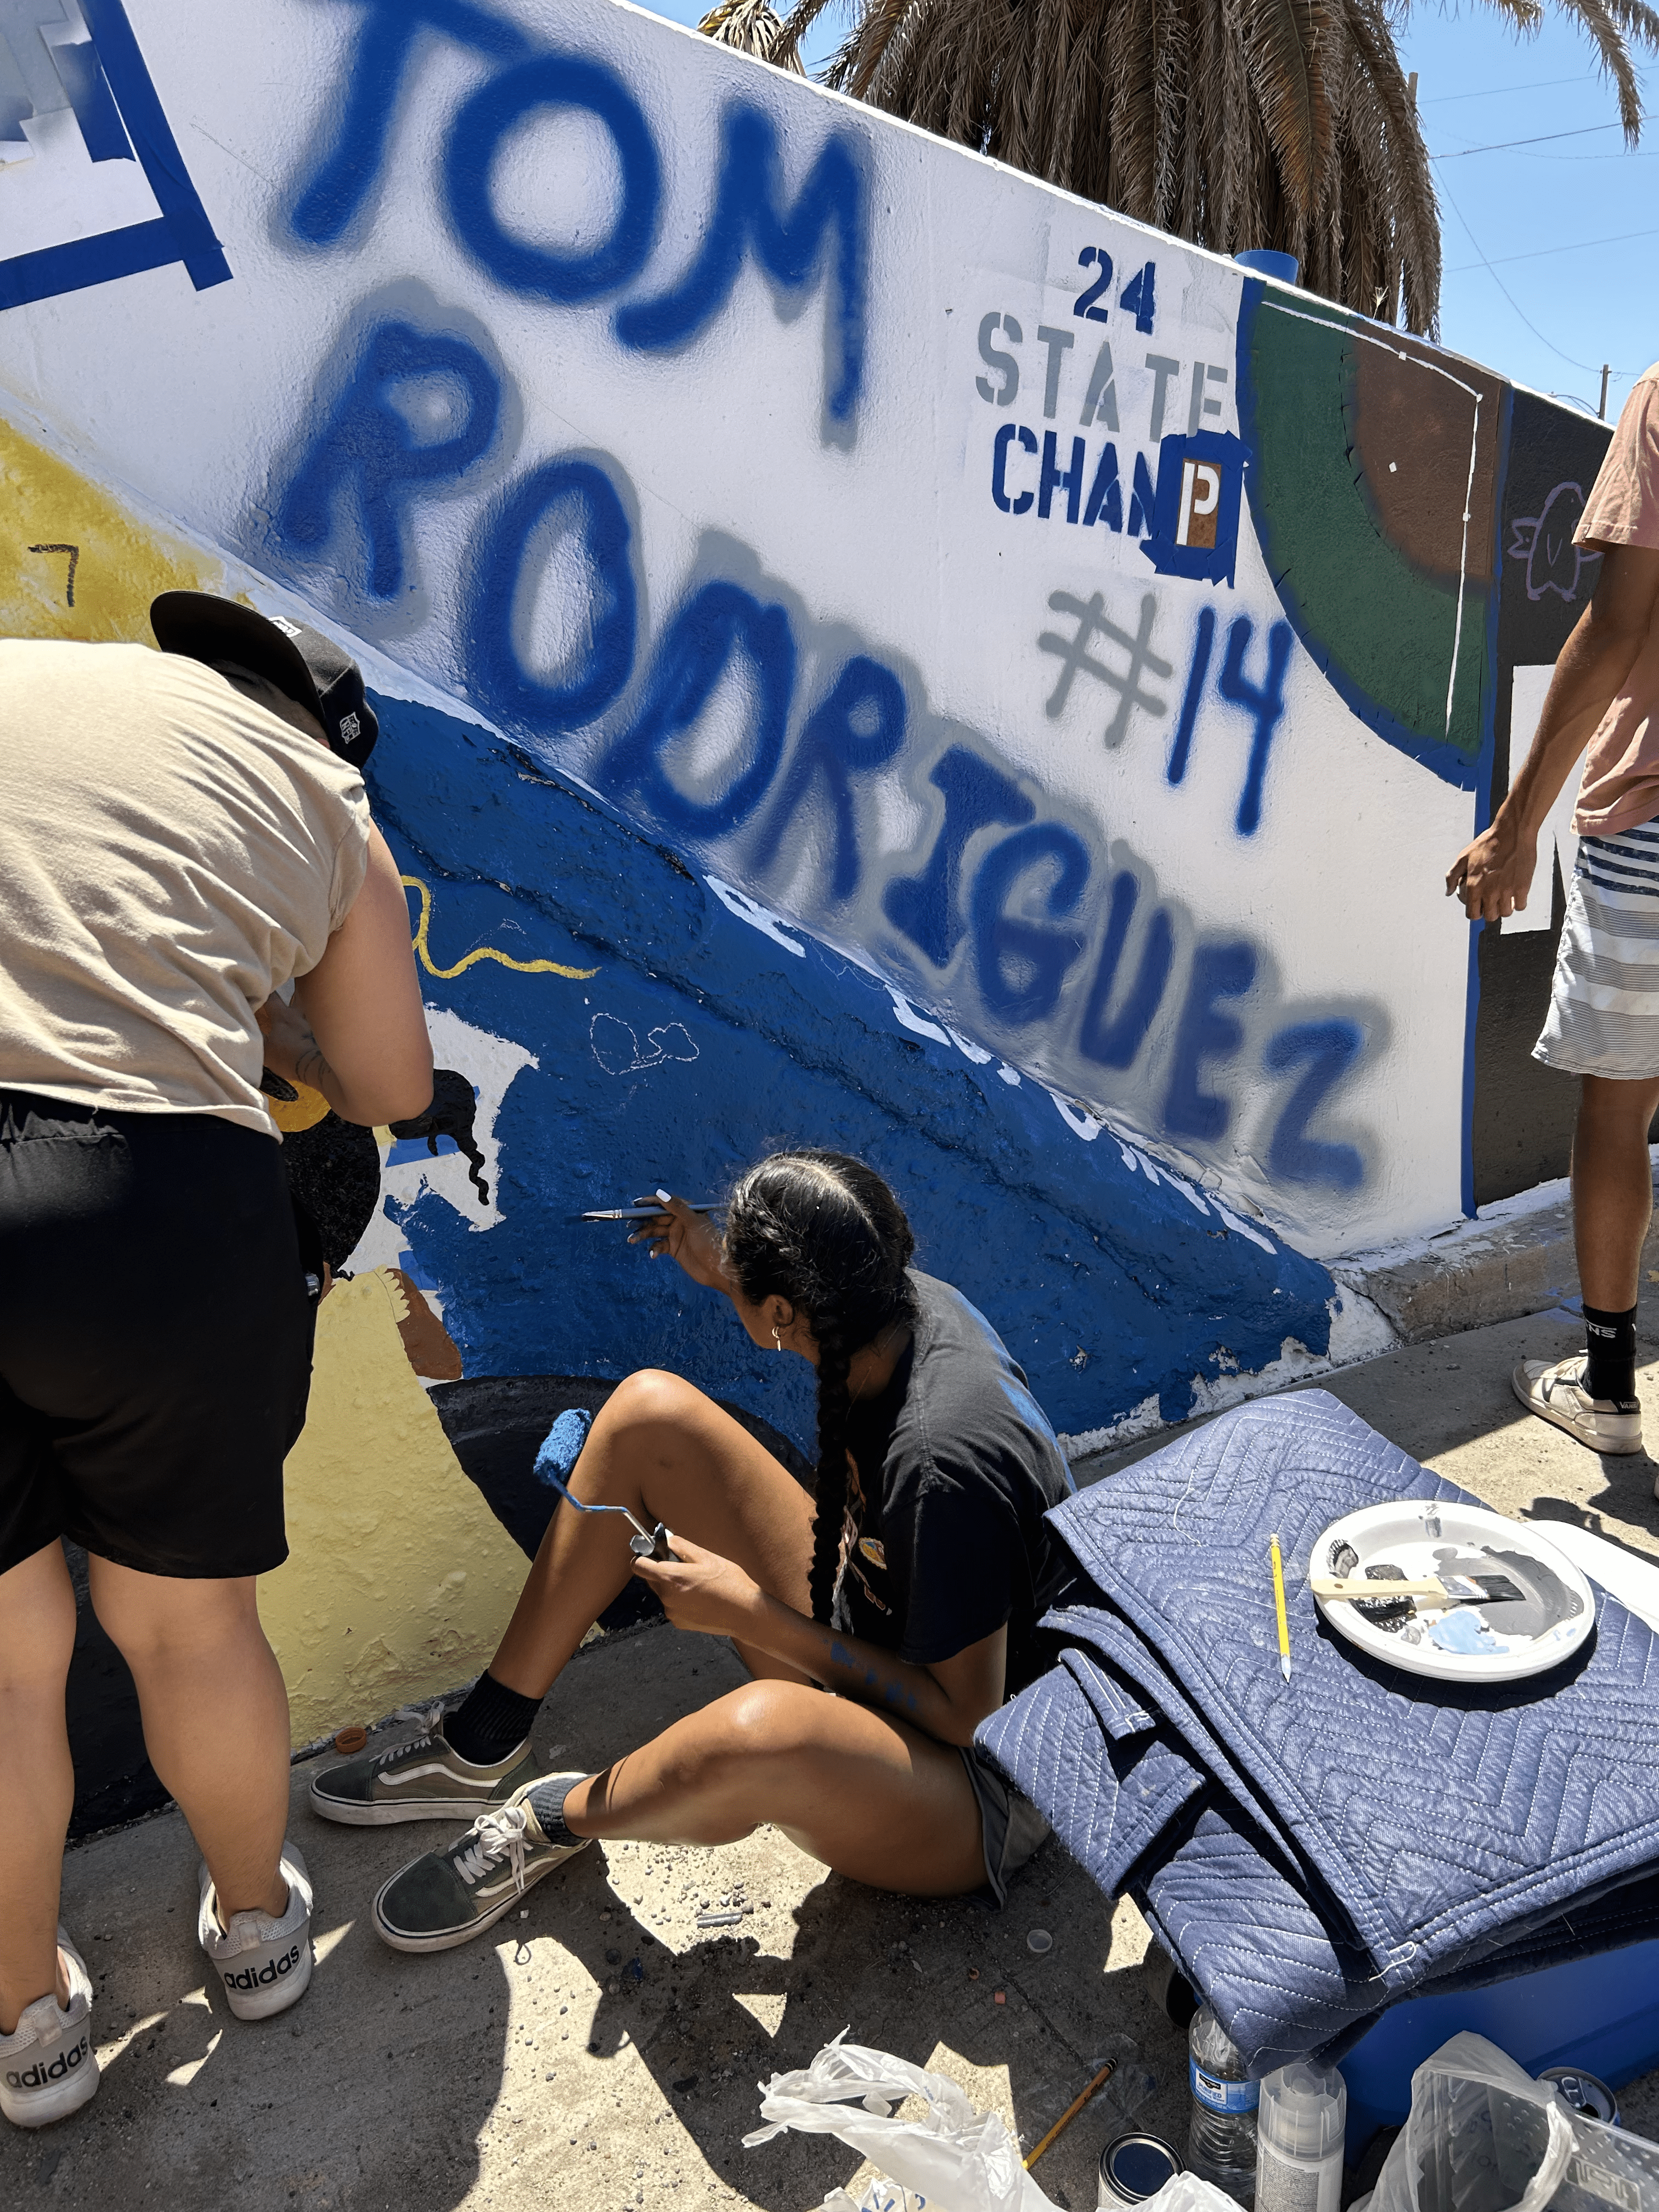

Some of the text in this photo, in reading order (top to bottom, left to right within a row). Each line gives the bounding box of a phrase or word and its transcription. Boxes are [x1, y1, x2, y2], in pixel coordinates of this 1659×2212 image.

[277, 0, 870, 447] TOM
[1074, 247, 1156, 335] 24
[976, 312, 1228, 443] STATE
[272, 299, 1377, 1196] RODRIGUEZ
[1039, 591, 1294, 836] #14
[224, 1944, 300, 1990] adidas
[6, 2035, 88, 2088] adidas
